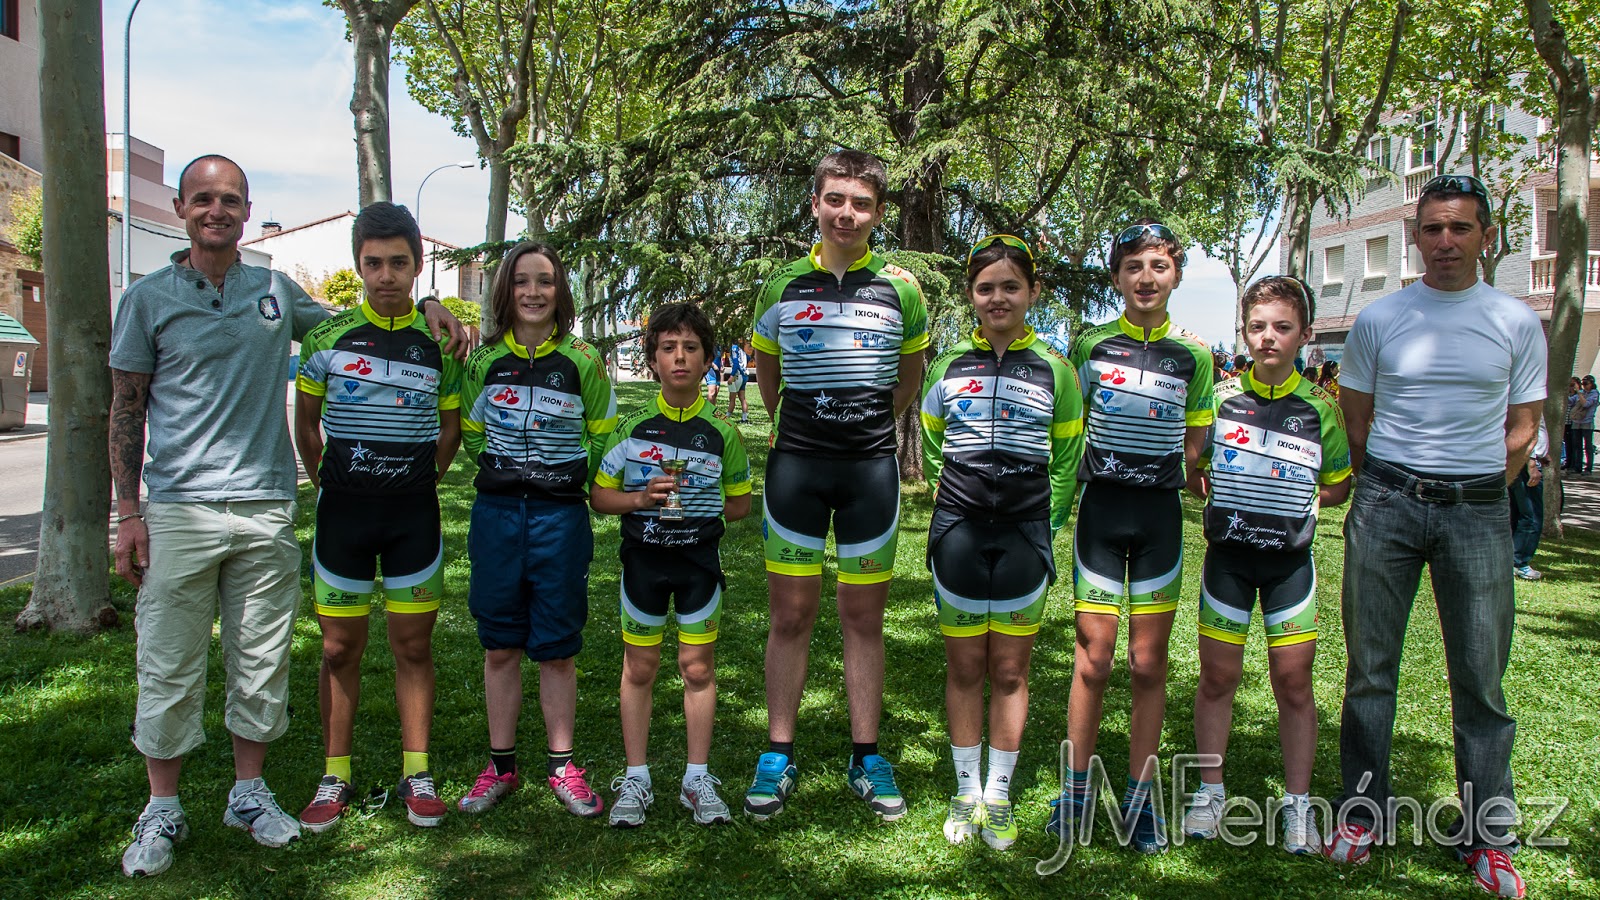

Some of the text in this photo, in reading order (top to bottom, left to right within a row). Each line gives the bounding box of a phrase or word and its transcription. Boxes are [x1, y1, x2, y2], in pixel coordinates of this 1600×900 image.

[855, 309, 880, 319] IXION
[401, 369, 424, 380] IXION
[1005, 383, 1030, 395] IXION
[1154, 380, 1177, 391] IXION
[540, 395, 562, 407] IXION
[1277, 439, 1317, 458] IXION bikes
[687, 456, 707, 465] IXION
